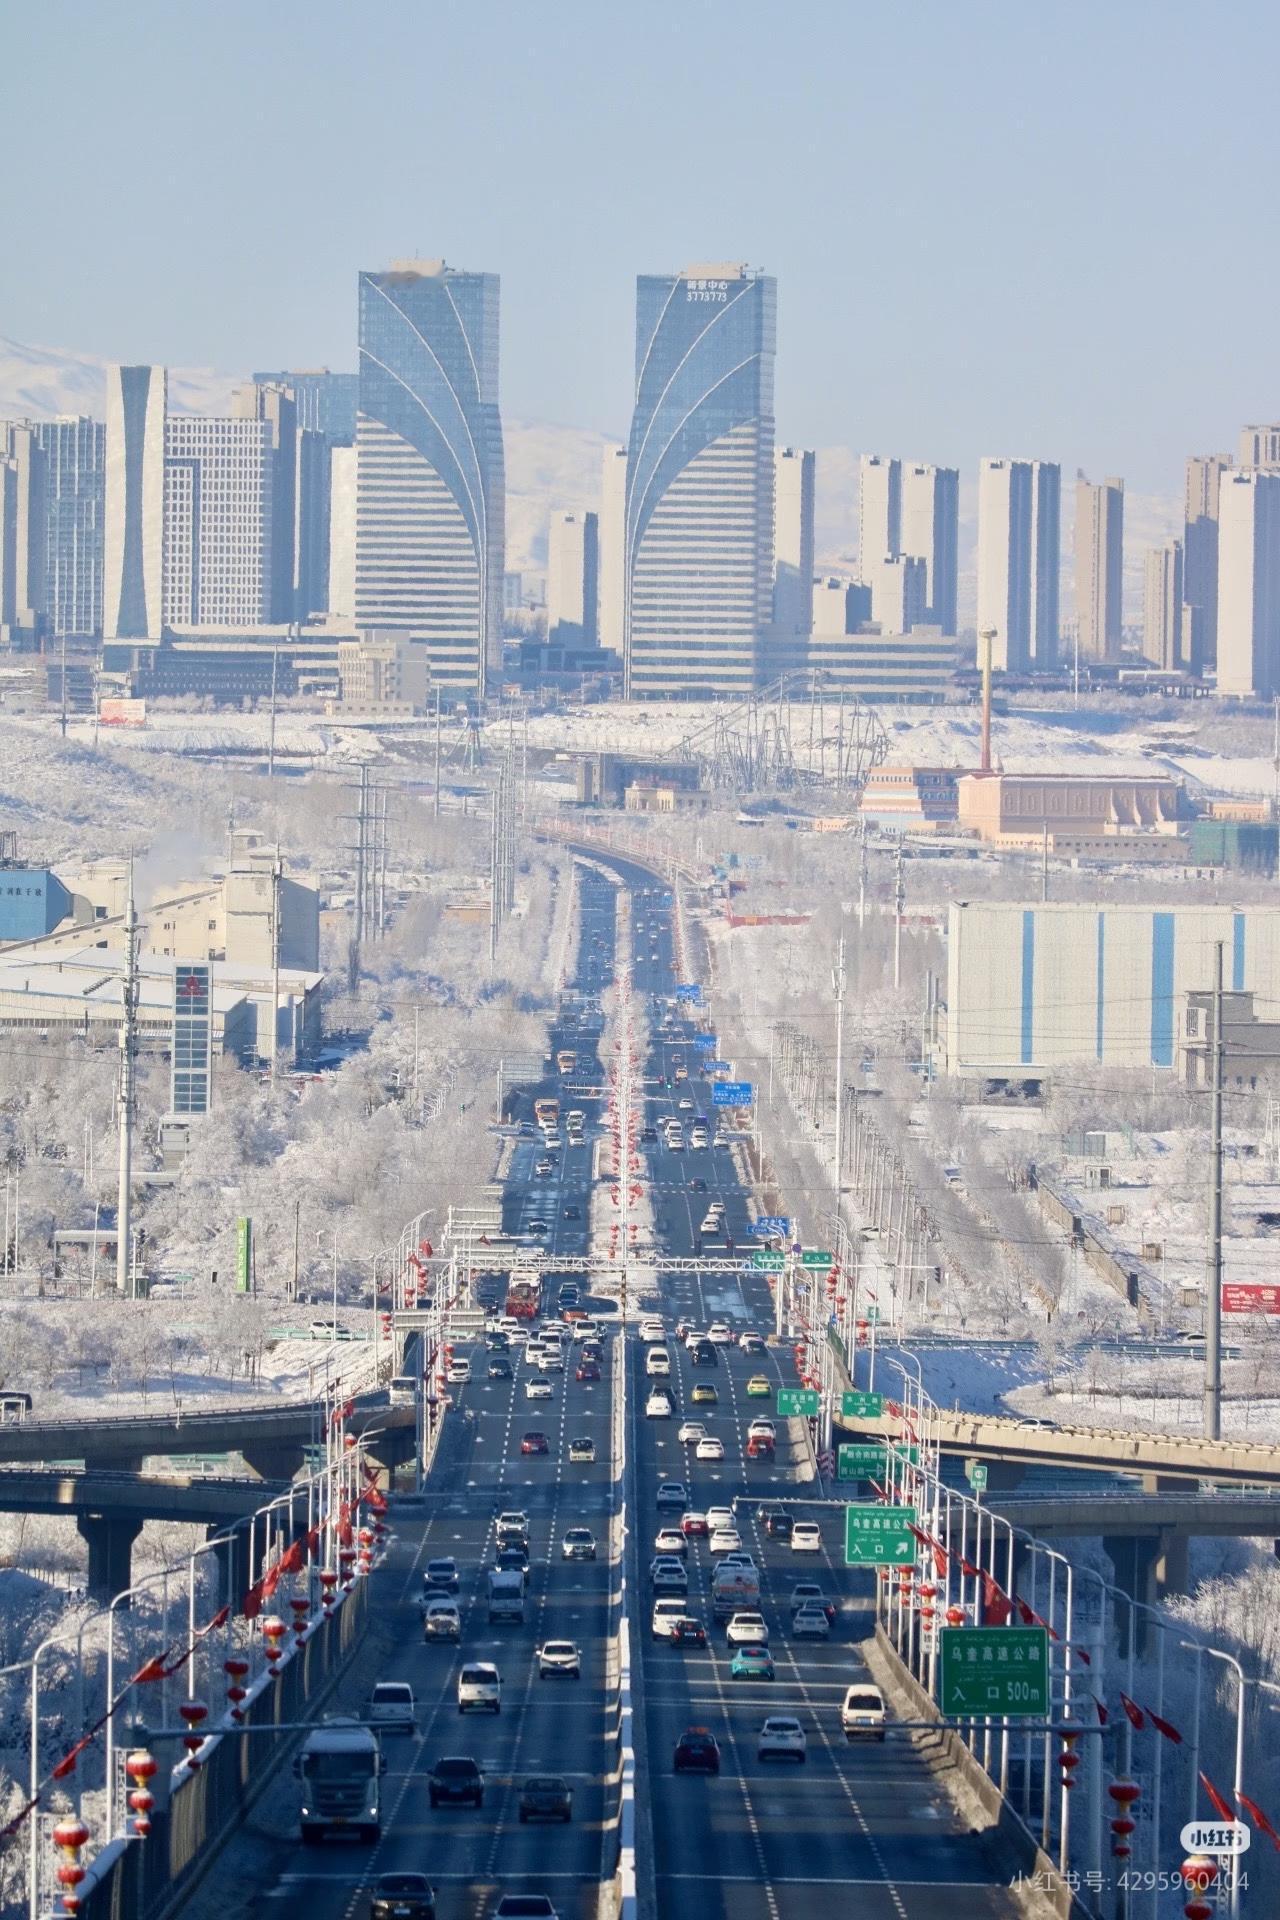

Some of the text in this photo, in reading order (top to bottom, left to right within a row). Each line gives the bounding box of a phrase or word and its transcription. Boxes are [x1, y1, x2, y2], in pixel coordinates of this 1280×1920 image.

[687, 291, 727, 302] 3773773
[951, 1645, 1041, 1662] 乌奎高速公路
[1006, 1681, 1040, 1702] 500m
